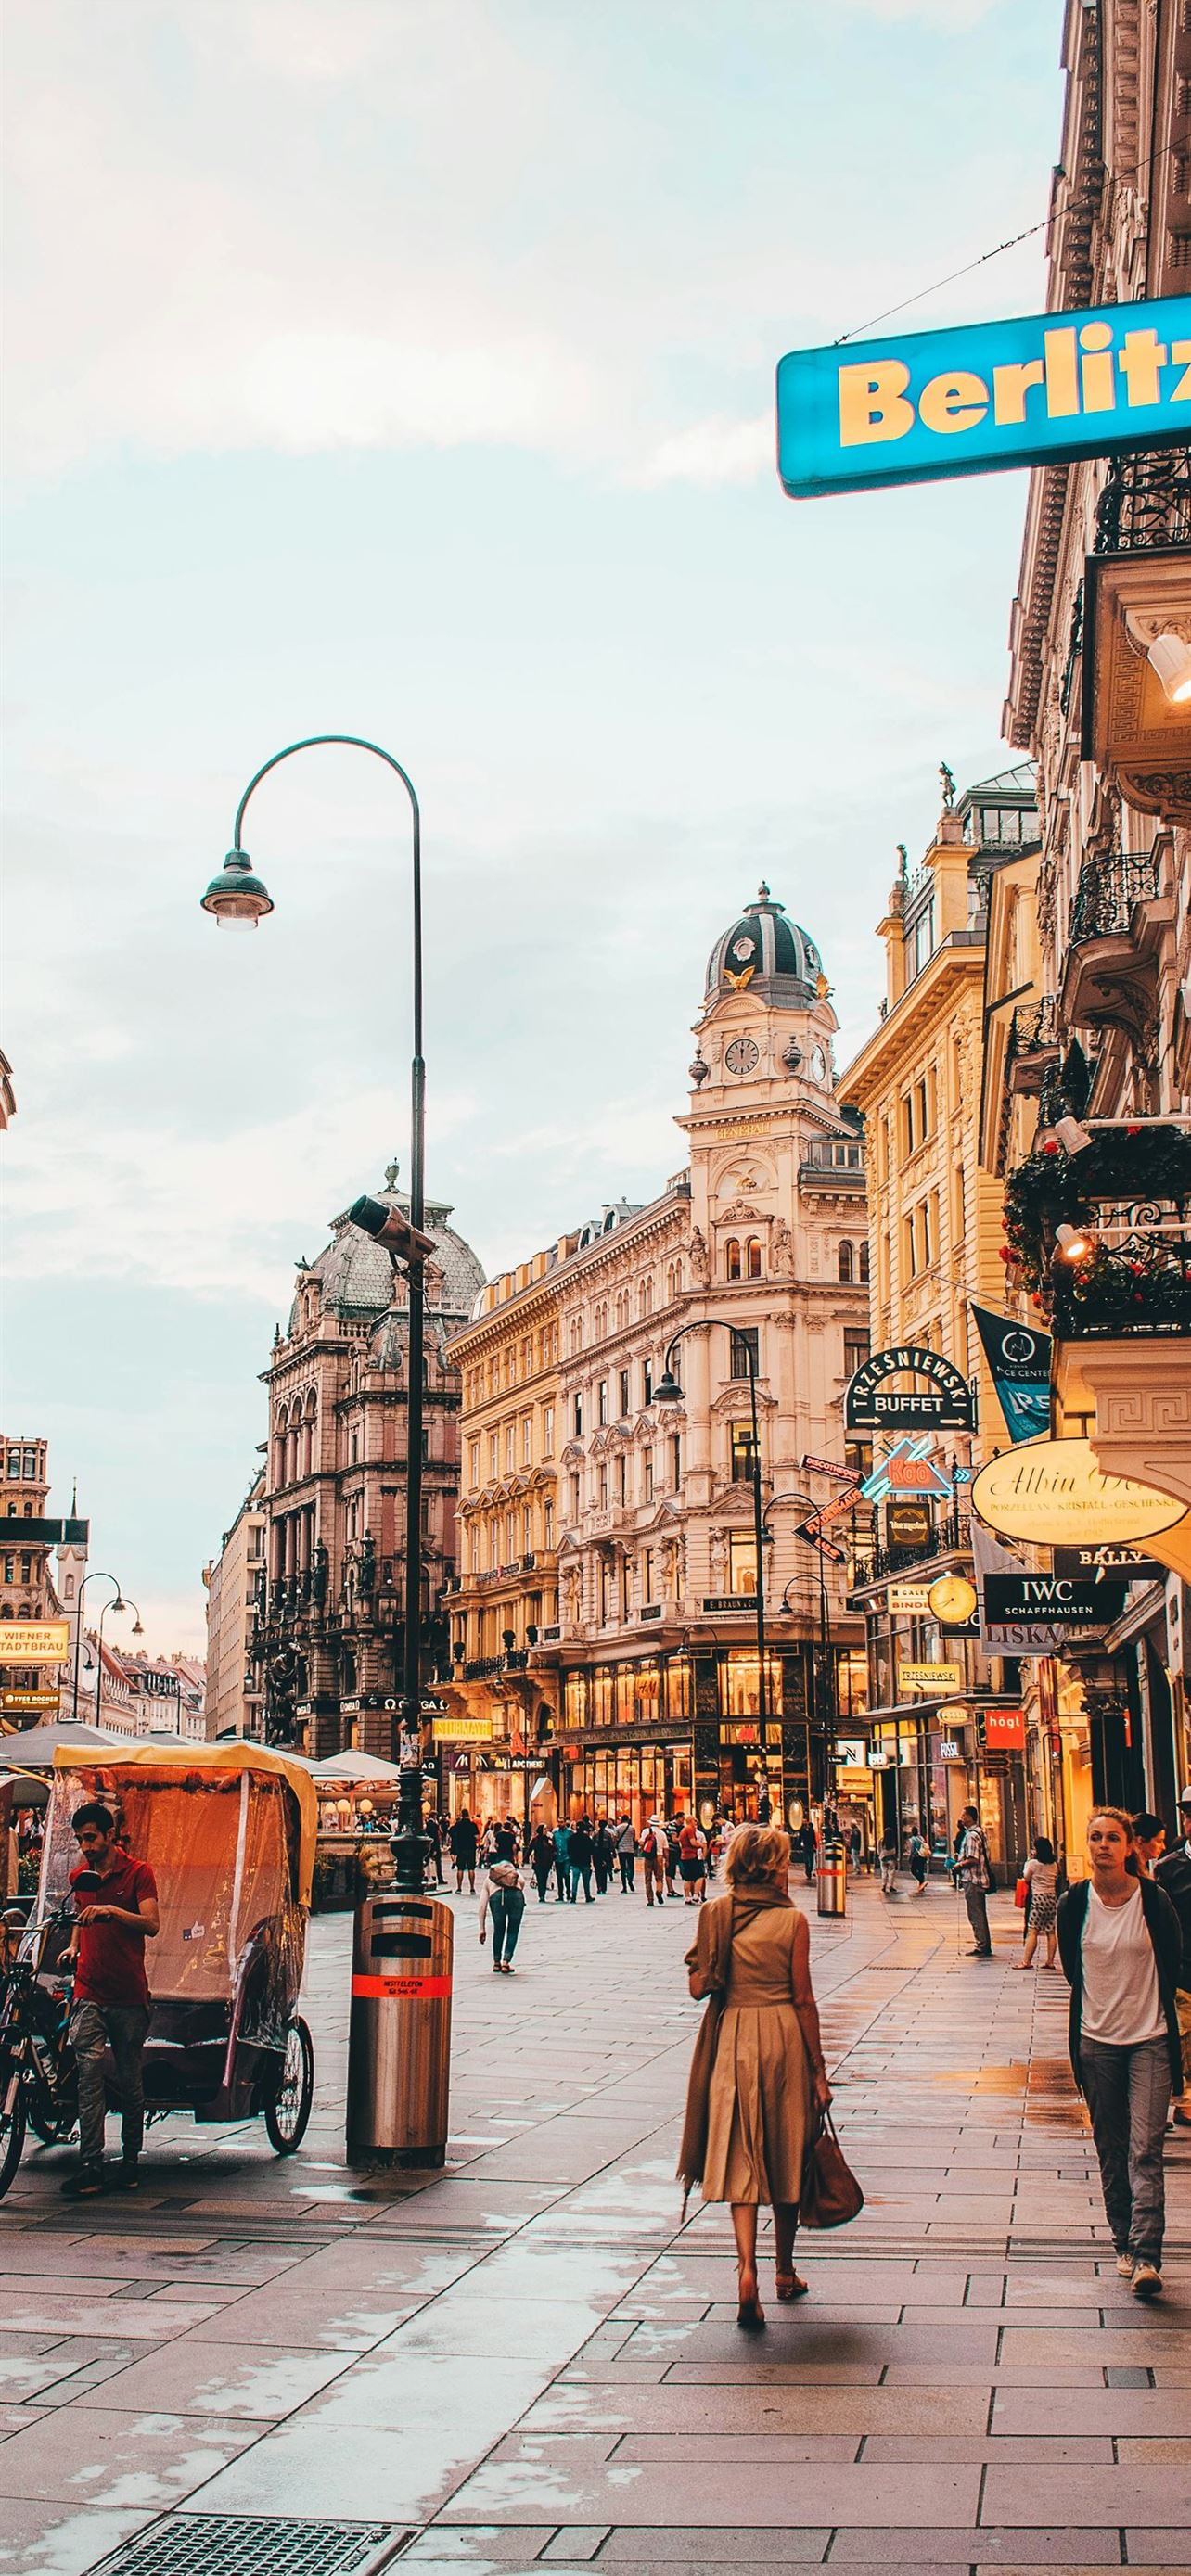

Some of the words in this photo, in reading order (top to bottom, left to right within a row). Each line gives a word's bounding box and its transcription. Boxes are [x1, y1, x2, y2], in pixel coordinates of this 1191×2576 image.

[715, 1123, 771, 1140] GENERALI
[875, 1397, 944, 1412] BUFFET
[806, 1457, 862, 1480] DISCOTHEQUE
[990, 1467, 1076, 1496] Albin
[991, 1503, 1050, 1512] PORZELLAN
[1057, 1500, 1107, 1511] KRISTALL
[1114, 1498, 1177, 1510] GESCHENKE
[1079, 1551, 1143, 1565] BALLY
[1022, 1580, 1073, 1601] IWC
[1005, 1606, 1094, 1615] SCHAFFHAUSEN
[5, 1632, 51, 1640] WIENER
[987, 1626, 1058, 1644] LISKA
[990, 1715, 1020, 1728] högl
